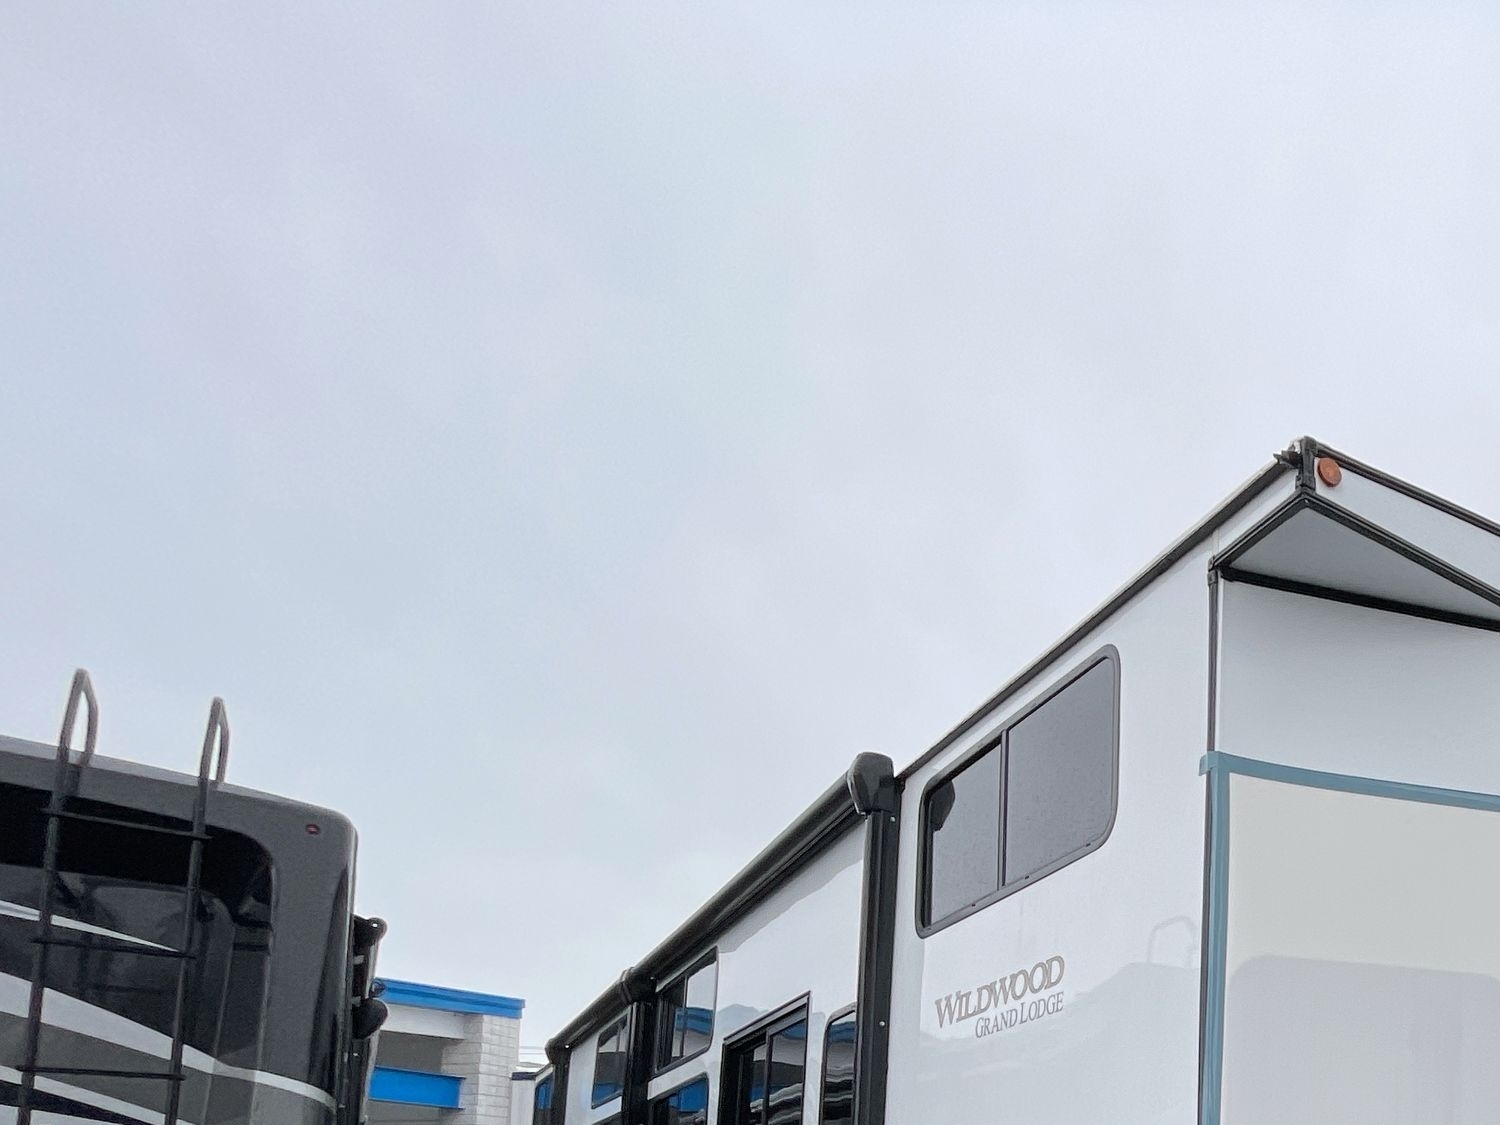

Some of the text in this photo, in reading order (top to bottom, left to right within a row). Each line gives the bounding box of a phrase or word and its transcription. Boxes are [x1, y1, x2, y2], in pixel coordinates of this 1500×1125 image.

[934, 955, 1065, 1029] WILDWOOD
[975, 991, 1064, 1039] GRAND LODGE
